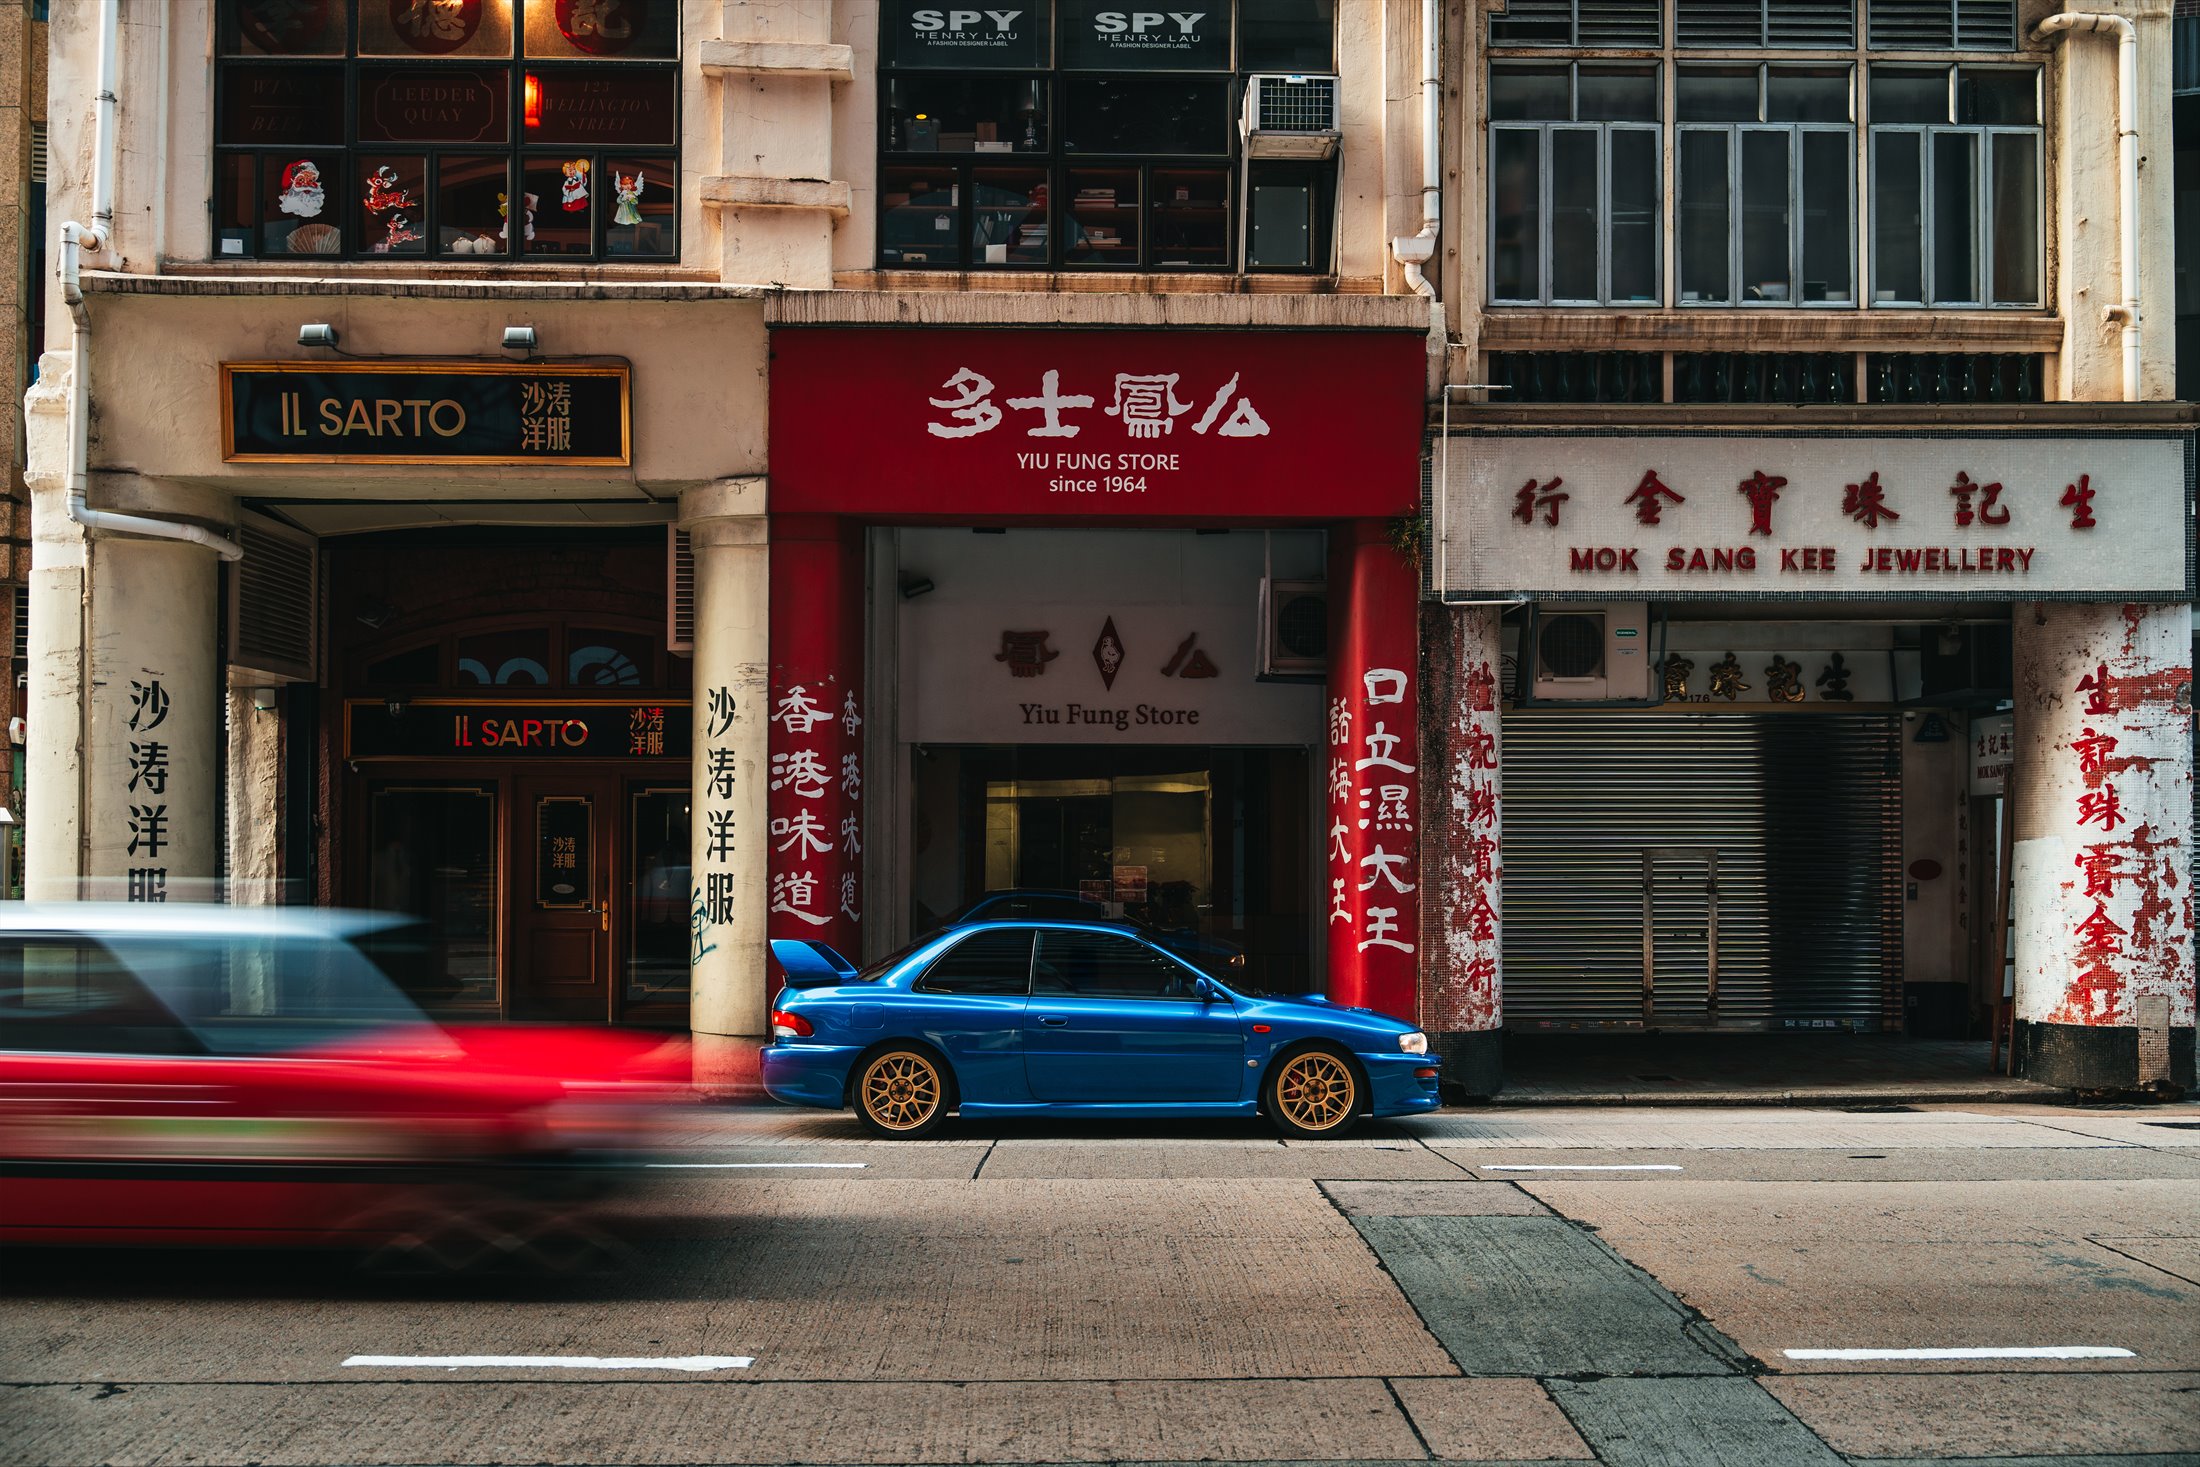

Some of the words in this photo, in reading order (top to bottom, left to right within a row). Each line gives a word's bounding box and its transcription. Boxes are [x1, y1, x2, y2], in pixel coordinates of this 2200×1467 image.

[912, 10, 1023, 31] SPY
[1094, 12, 1206, 33] SPY
[986, 32, 1018, 40] LAU
[1098, 34, 1161, 42] HENRY
[1169, 34, 1201, 42] LAU
[392, 87, 477, 102] LEEDER
[582, 80, 612, 93] 123
[544, 97, 653, 112] WELLINGTON
[404, 107, 463, 124] QUAY
[567, 117, 629, 131] STREET
[282, 392, 307, 436] IL
[319, 398, 466, 438] SARTO
[1017, 452, 1049, 470] YIU
[1056, 453, 1111, 470] FUNG
[1117, 453, 1180, 471] STORE
[1049, 475, 1097, 493] since
[1103, 476, 1147, 493] 1964
[1570, 547, 1639, 572] MOK
[1666, 547, 1756, 572] SANG
[1781, 547, 1836, 572] KEE
[1861, 547, 2035, 573] JEWELLERY
[1689, 694, 1711, 703] 176
[1020, 703, 1061, 725] Yiu
[1066, 703, 1130, 732] Fung
[1135, 703, 1200, 726] Store
[455, 715, 473, 747] IL
[481, 718, 588, 747] SARTO
[706, 686, 736, 926] 沙涛洋服
[771, 685, 834, 926] 香港味道
[840, 689, 863, 923] 香港味道
[1329, 697, 1353, 925] 話梅大王
[1355, 667, 1416, 954] 口立濕大王
